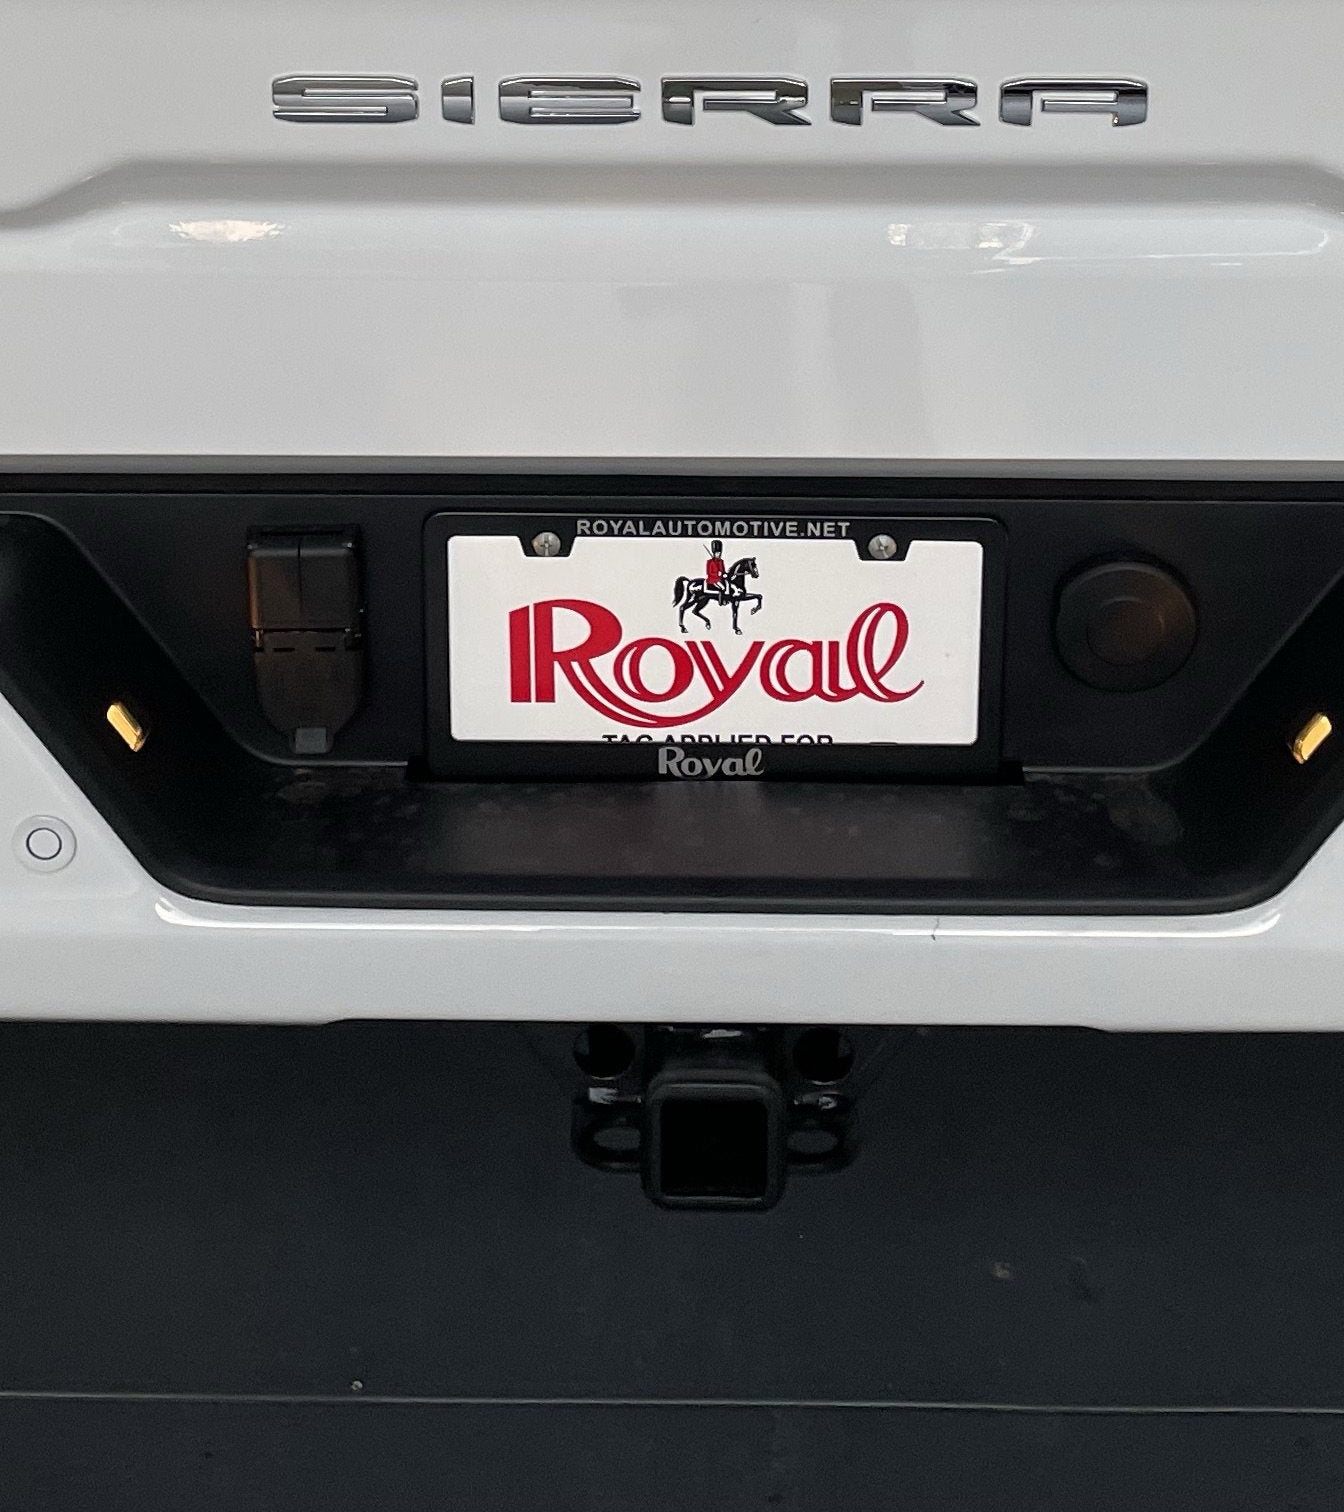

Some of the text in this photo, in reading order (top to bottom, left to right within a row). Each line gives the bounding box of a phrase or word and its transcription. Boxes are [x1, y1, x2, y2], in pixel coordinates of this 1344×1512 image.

[271, 75, 1148, 126] SIERRA
[576, 519, 851, 537] ROYALAUTOMOTIVE.NET
[508, 598, 924, 728] Royal
[658, 746, 765, 779] Royal
